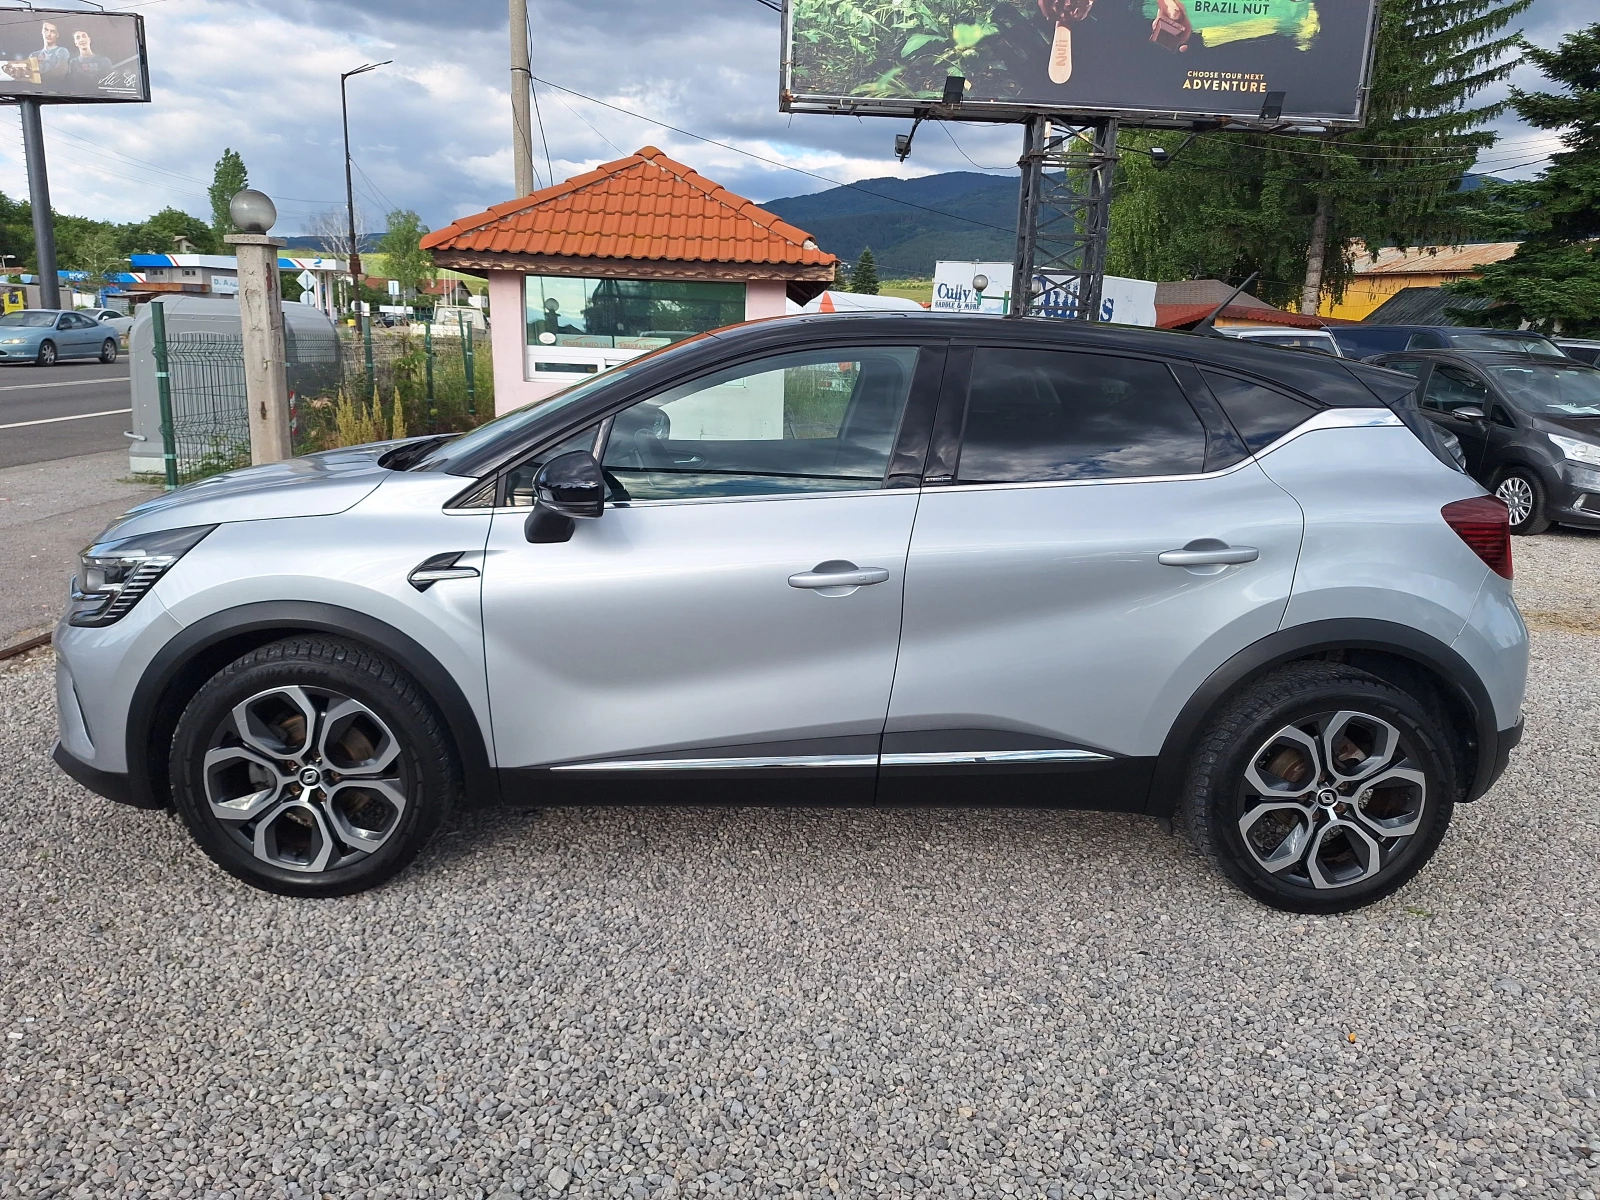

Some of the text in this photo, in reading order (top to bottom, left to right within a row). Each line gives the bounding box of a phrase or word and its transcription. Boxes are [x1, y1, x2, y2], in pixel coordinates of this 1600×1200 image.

[1195, 1, 1270, 15] BRAZIL NUT
[1182, 78, 1267, 93] ADVENTURE
